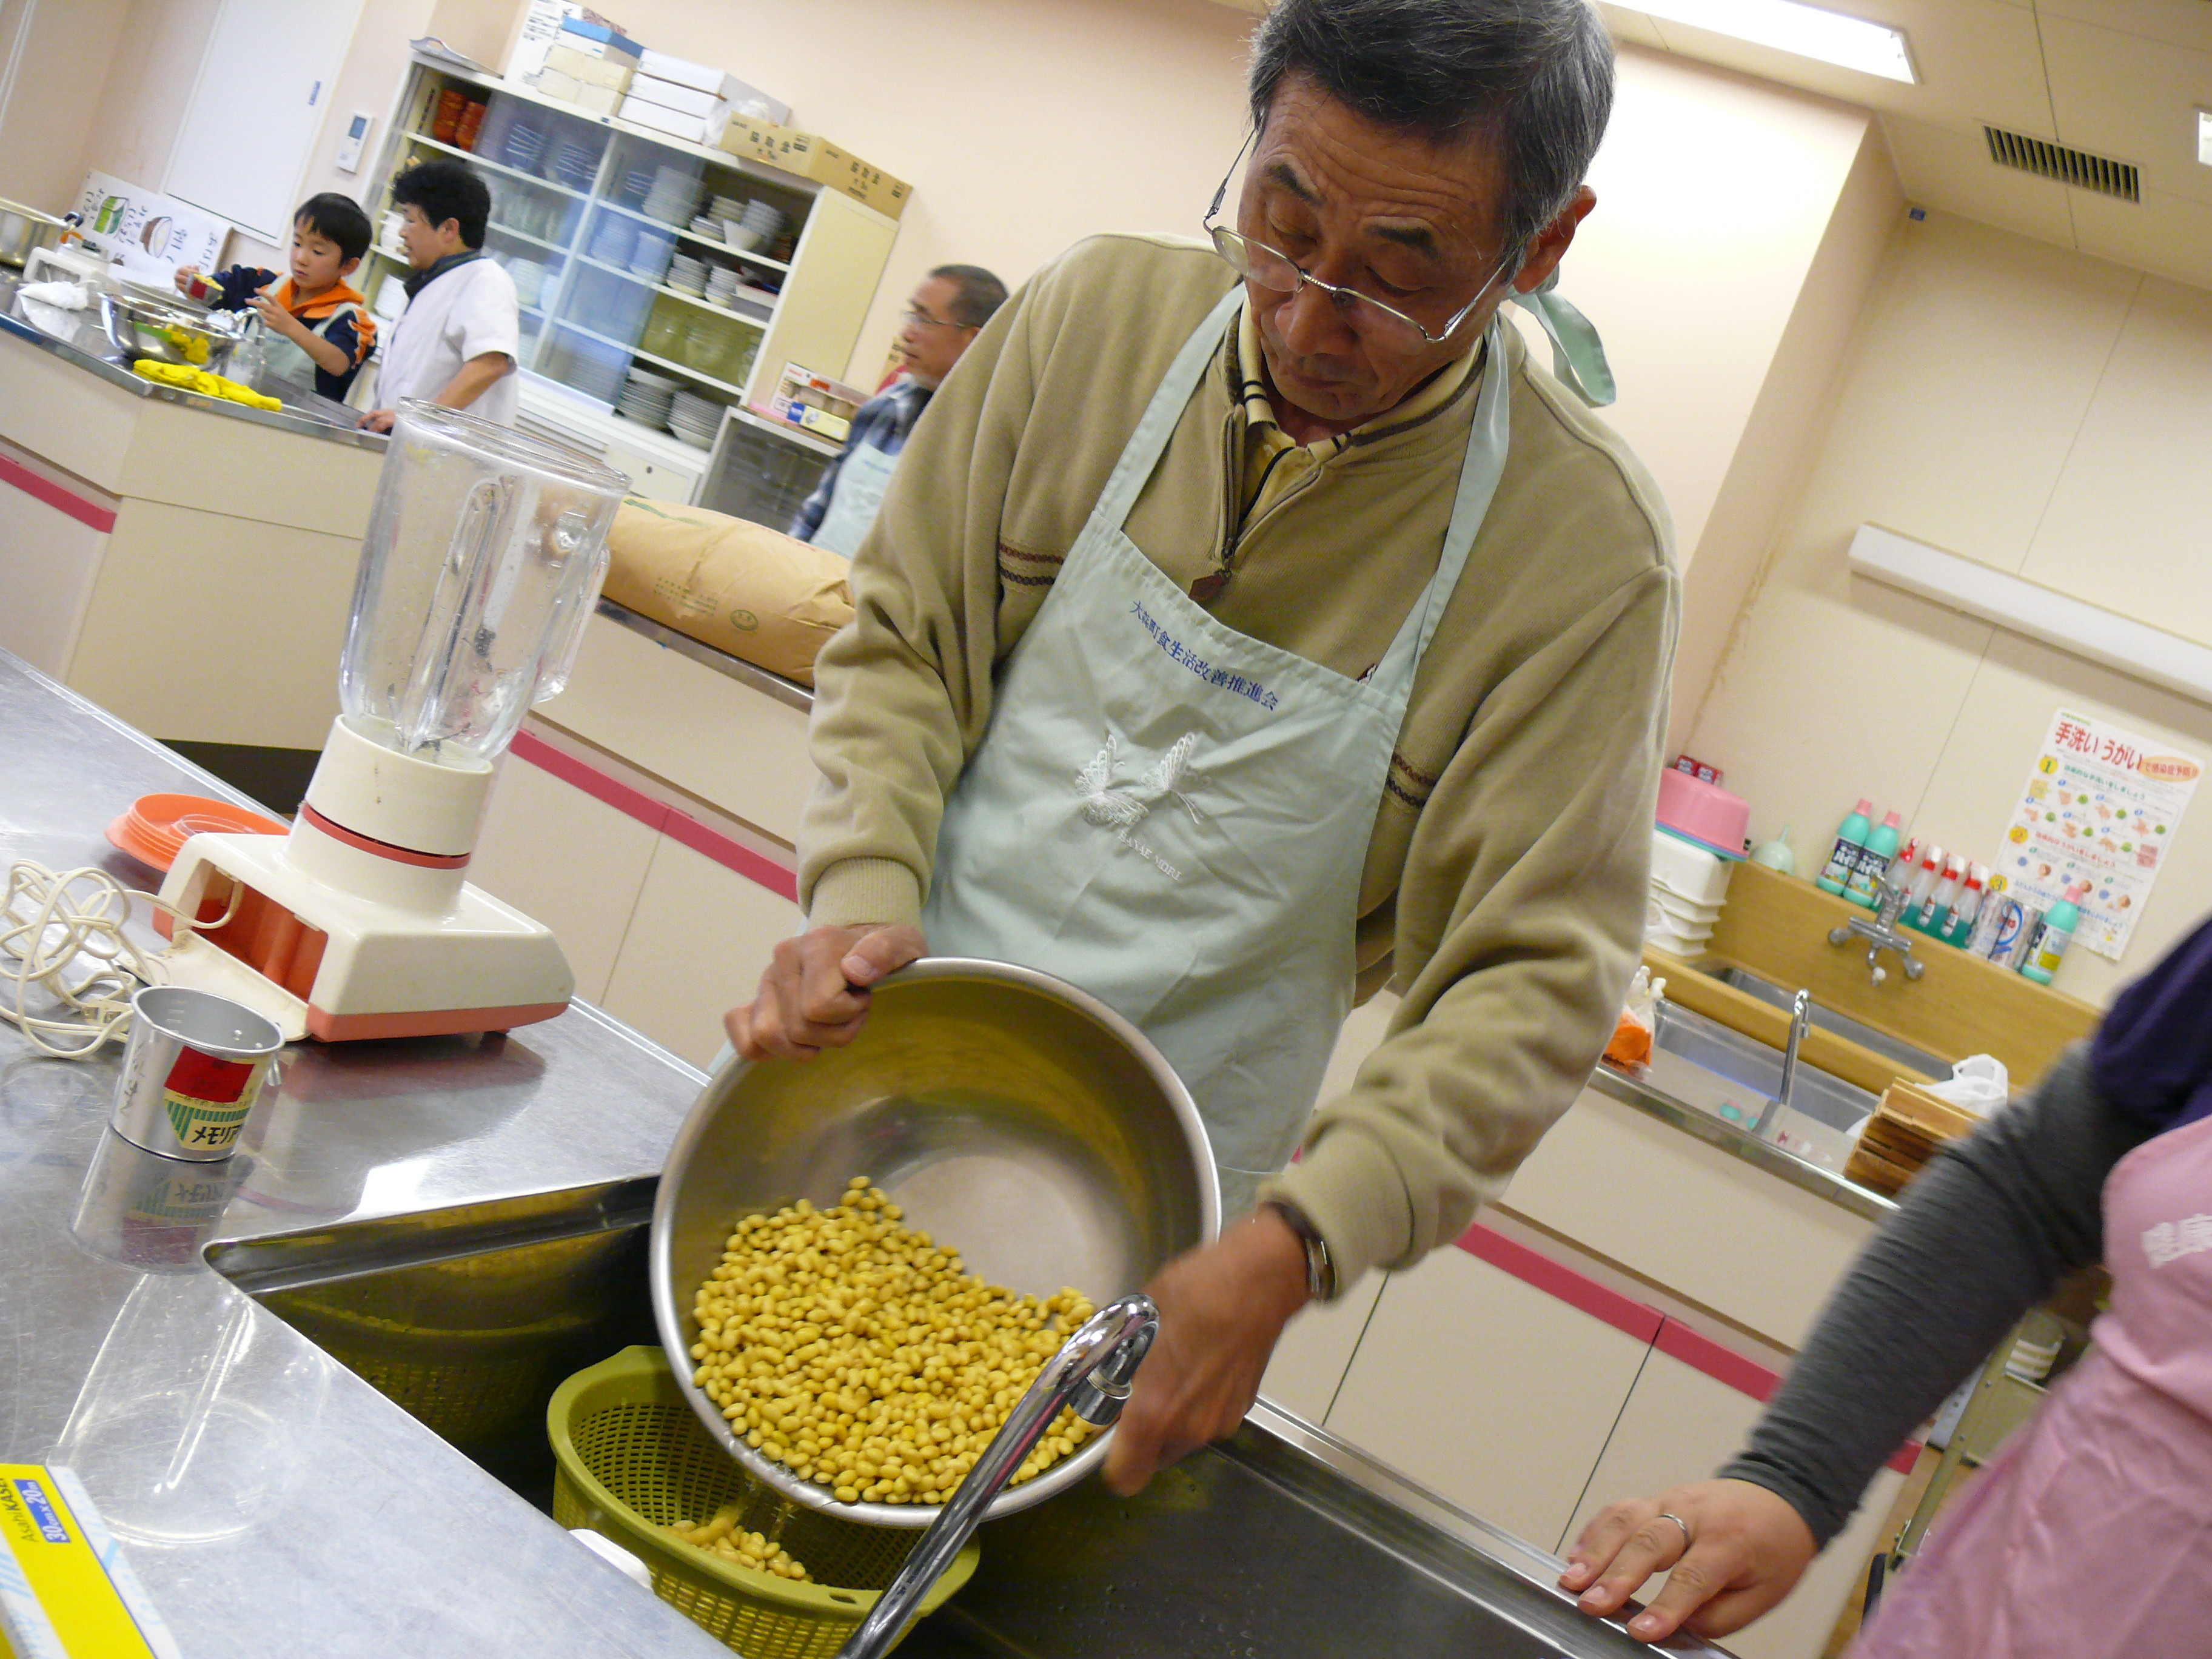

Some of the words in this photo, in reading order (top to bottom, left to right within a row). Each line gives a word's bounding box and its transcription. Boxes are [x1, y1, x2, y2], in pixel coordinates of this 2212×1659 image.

[2056, 722, 2099, 753] 手洗い
[2102, 740, 2143, 770] うがい
